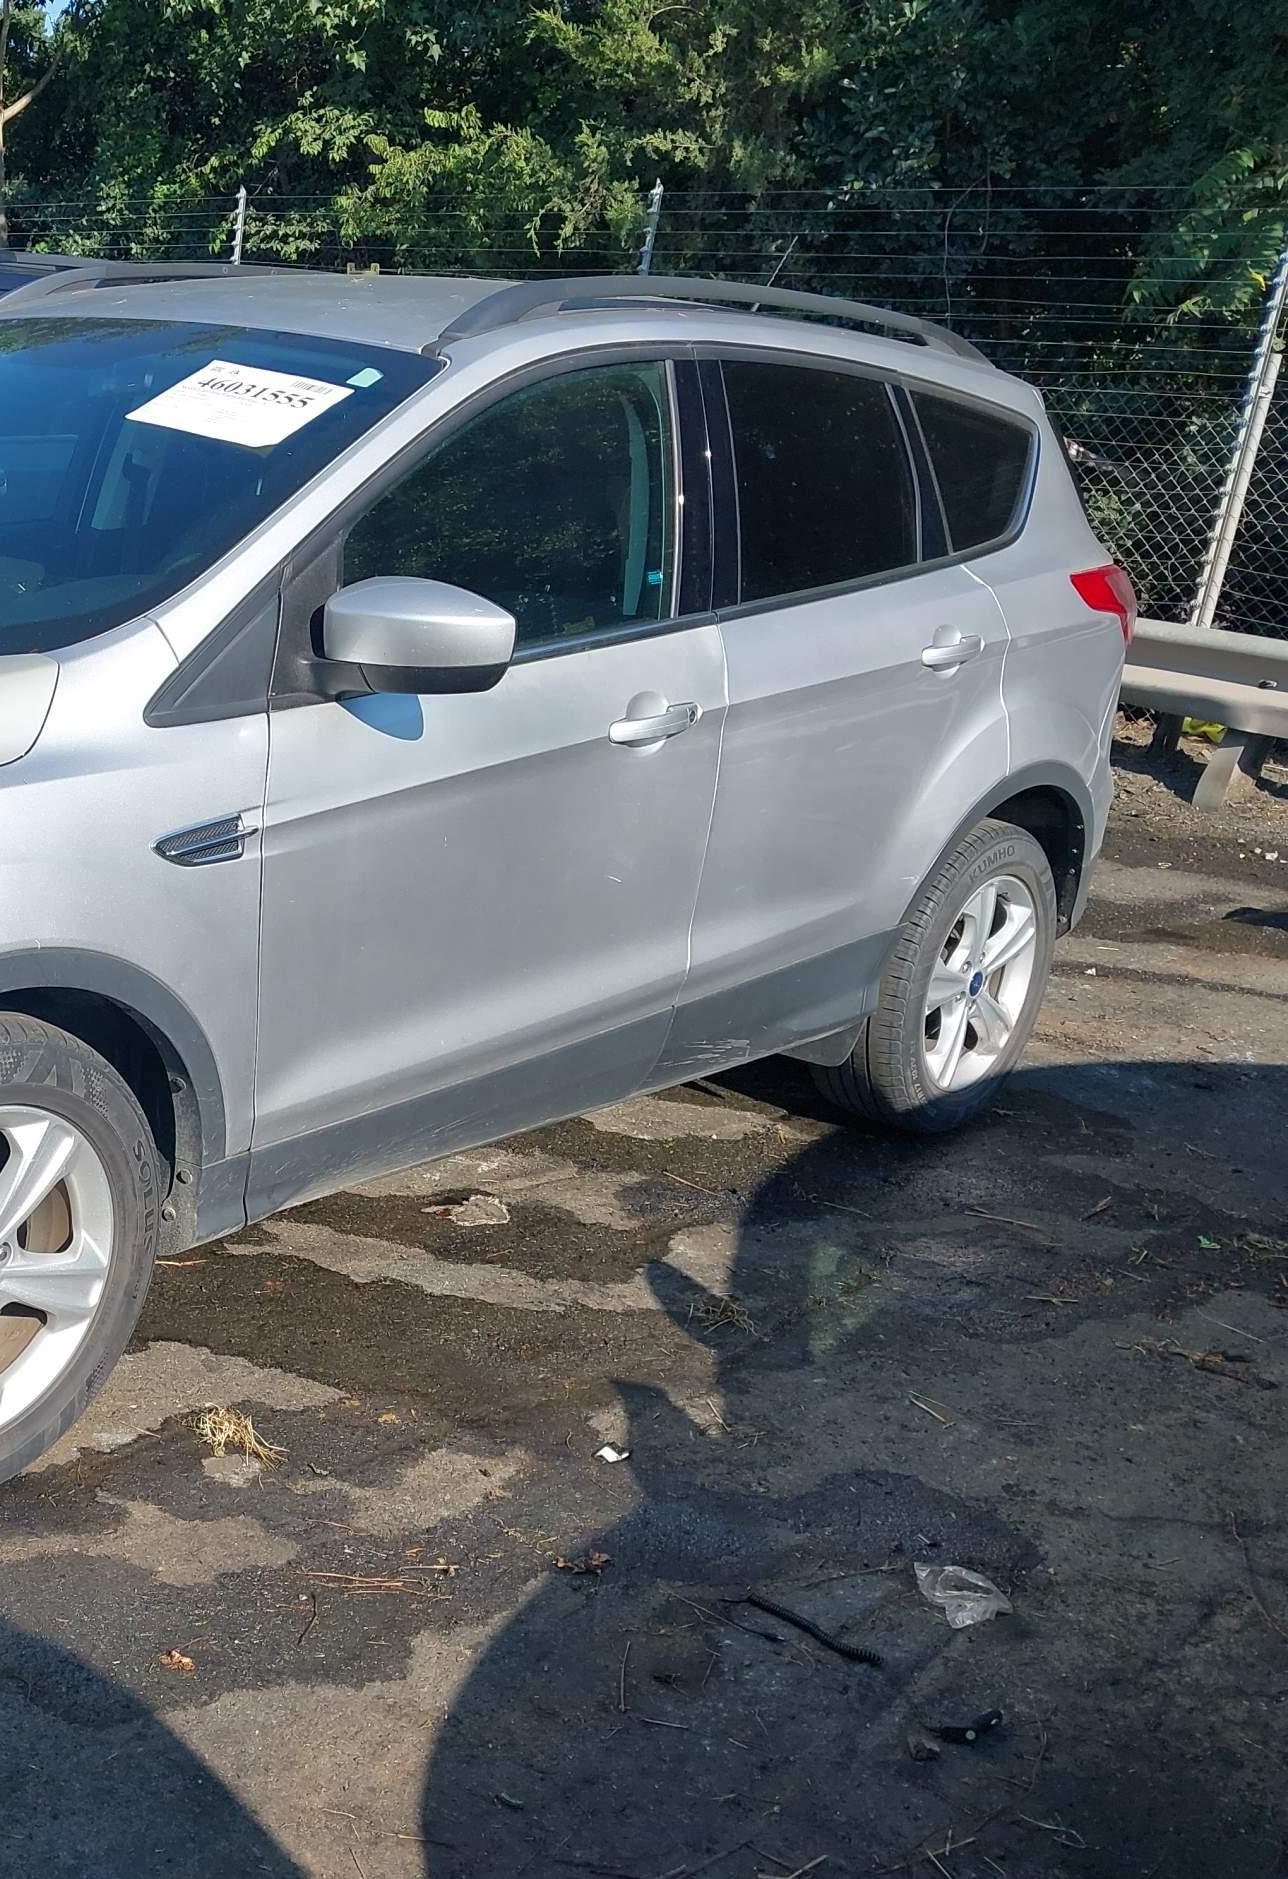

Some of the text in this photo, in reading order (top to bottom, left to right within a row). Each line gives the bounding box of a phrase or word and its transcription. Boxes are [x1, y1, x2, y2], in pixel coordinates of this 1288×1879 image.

[197, 377, 315, 408] 46031555
[969, 845, 1015, 883] KUMHO
[133, 1138, 155, 1256] SOLUS
